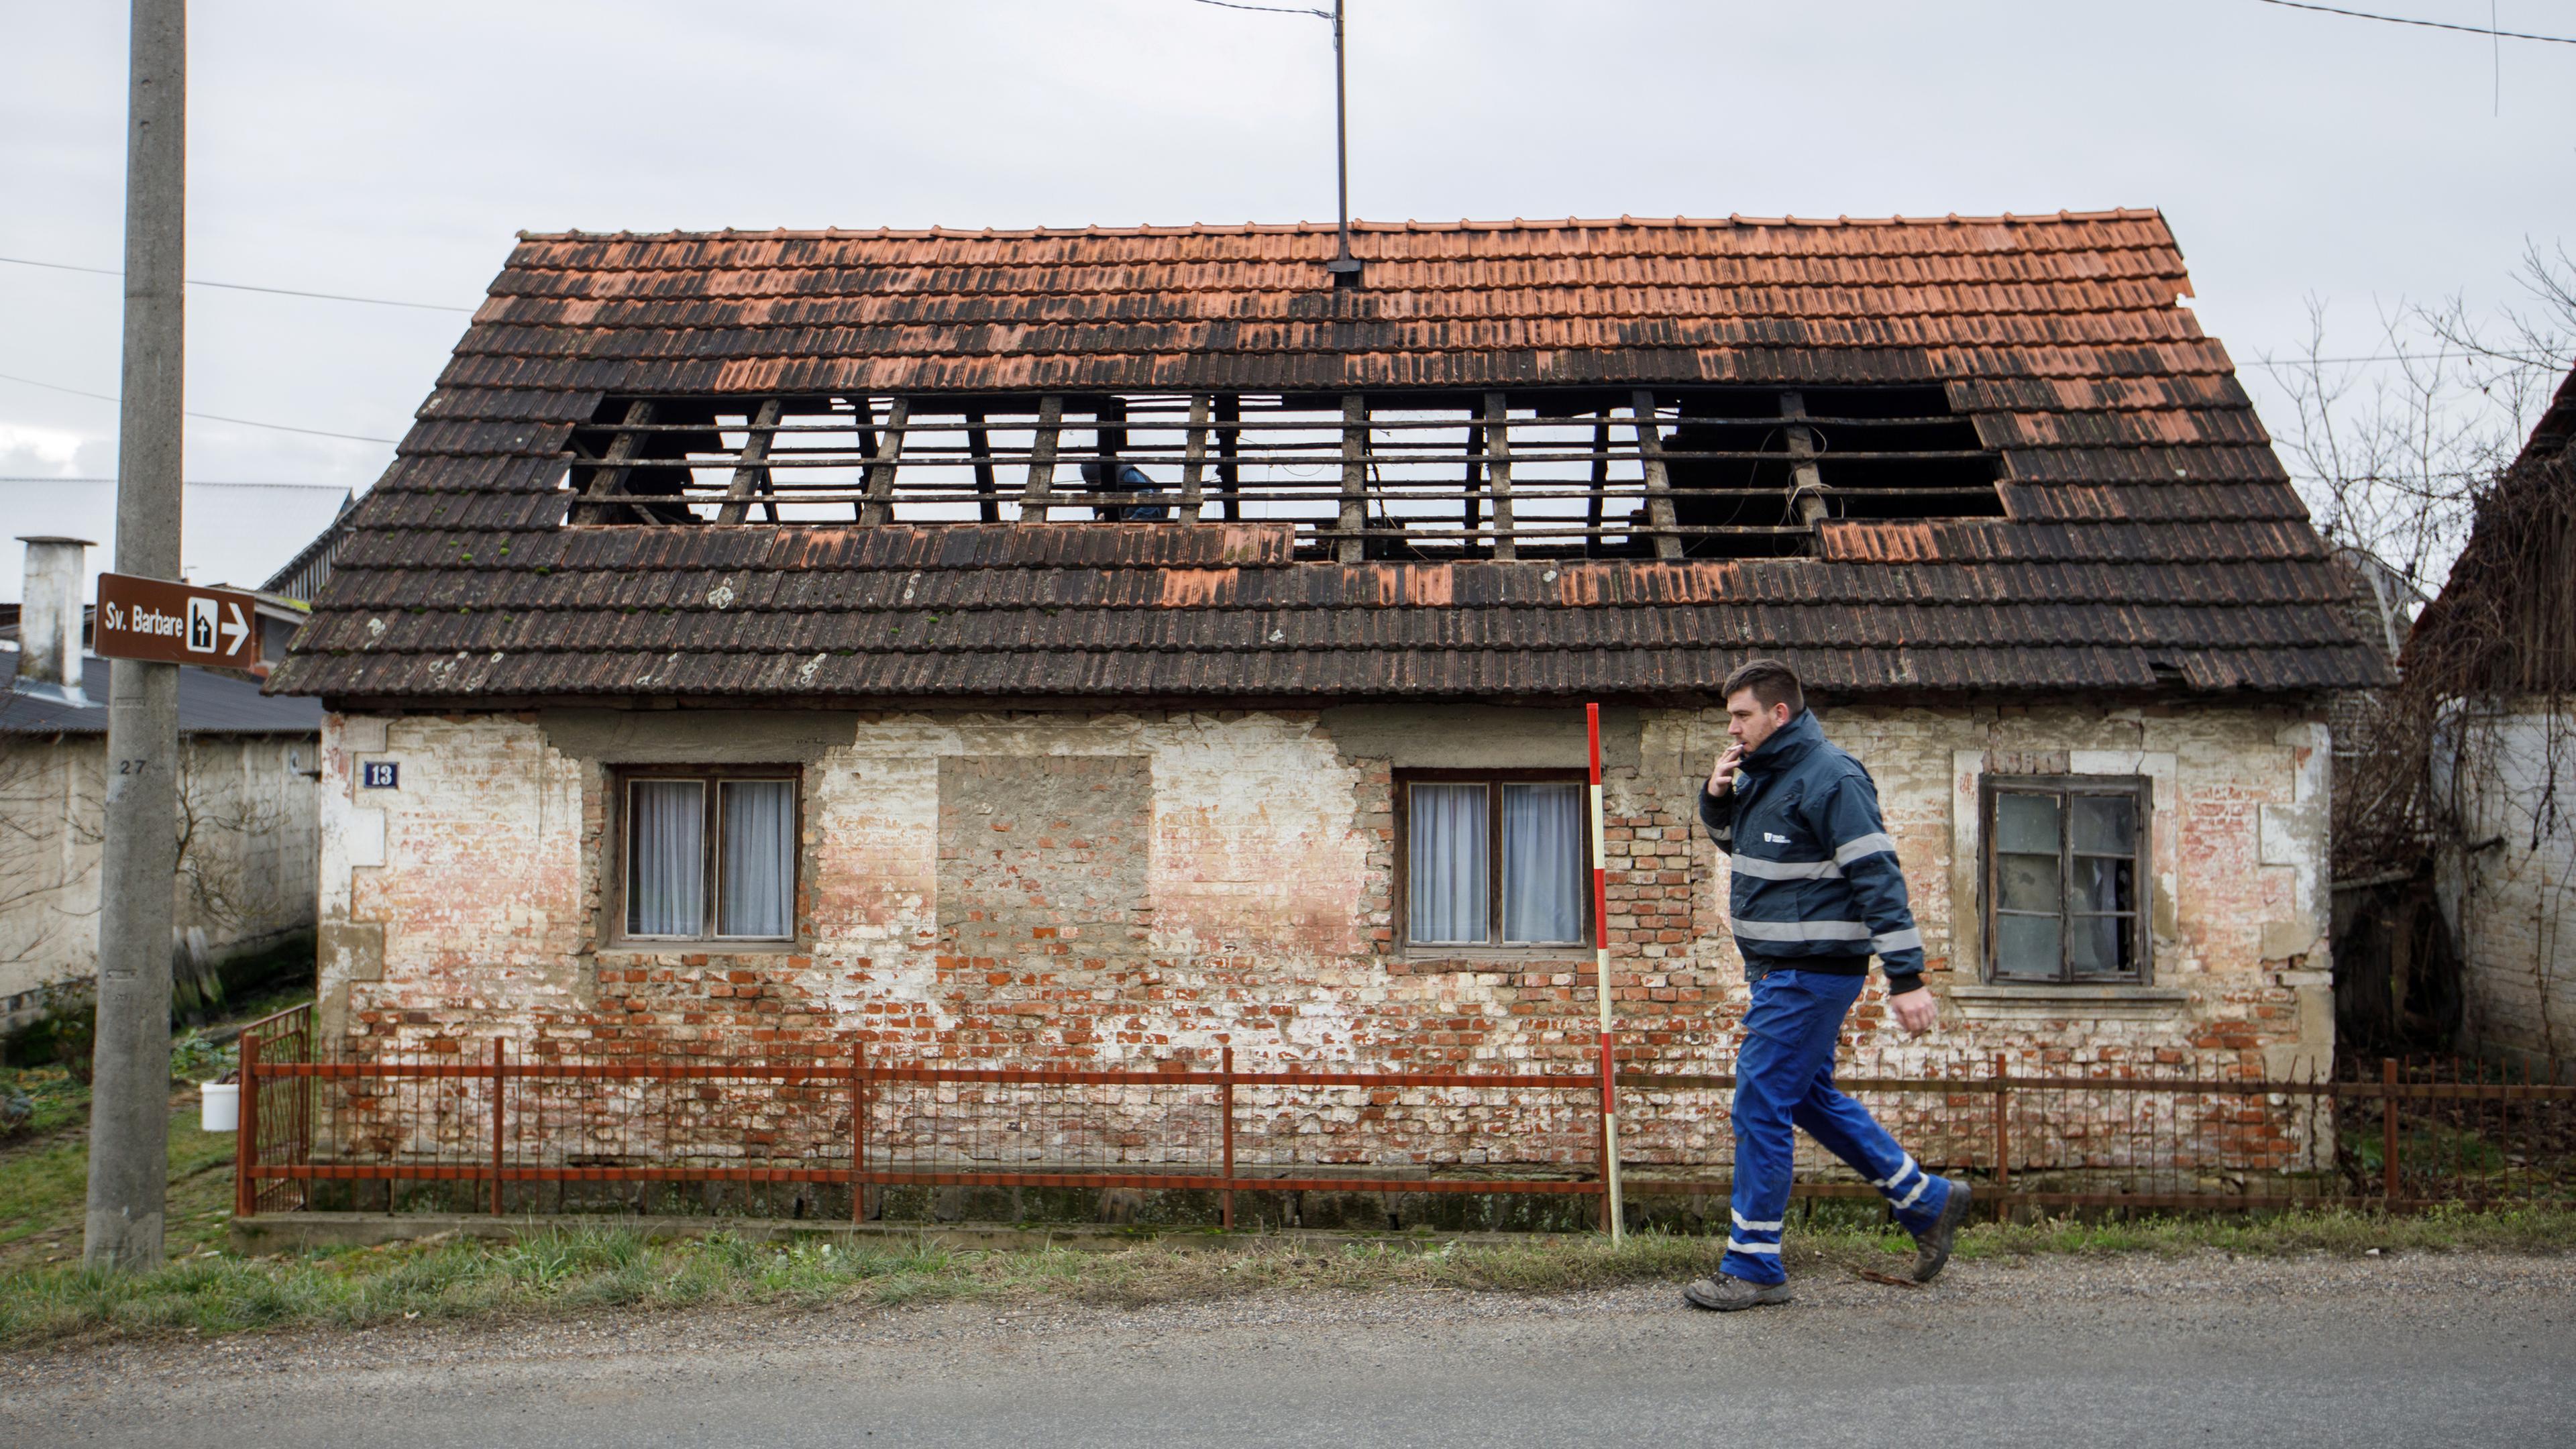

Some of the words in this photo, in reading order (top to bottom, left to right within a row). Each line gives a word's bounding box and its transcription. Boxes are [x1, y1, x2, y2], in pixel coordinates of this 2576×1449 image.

[105, 601, 126, 631] Sv.
[132, 604, 183, 637] Barbare
[121, 760, 146, 774] 27
[372, 765, 392, 785] 13
